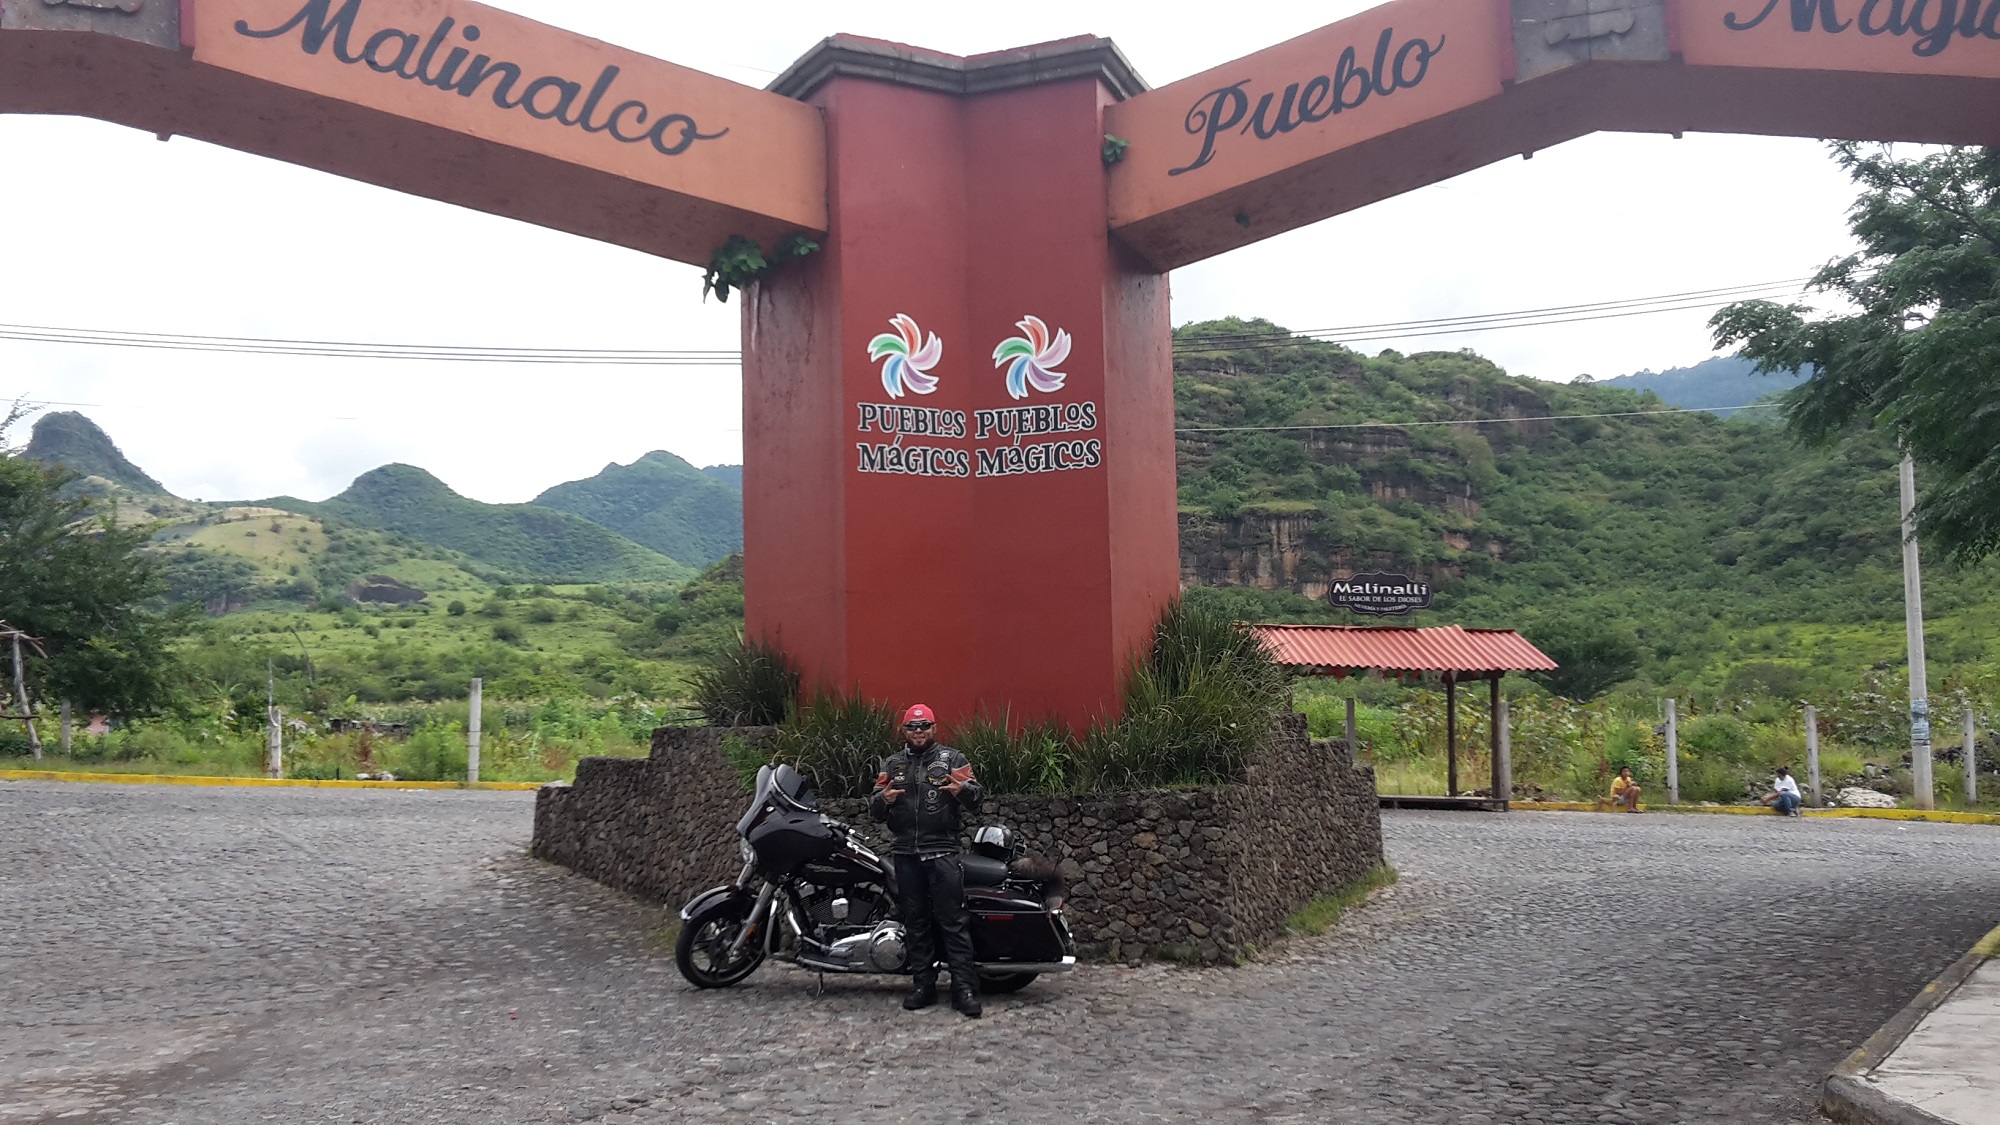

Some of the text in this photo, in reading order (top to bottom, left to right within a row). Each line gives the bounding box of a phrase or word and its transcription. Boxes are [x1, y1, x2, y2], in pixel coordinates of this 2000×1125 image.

[234, 0, 729, 155] Malinalco
[1168, 27, 1446, 176] Pueblo
[1333, 583, 1427, 595] Malinalli
